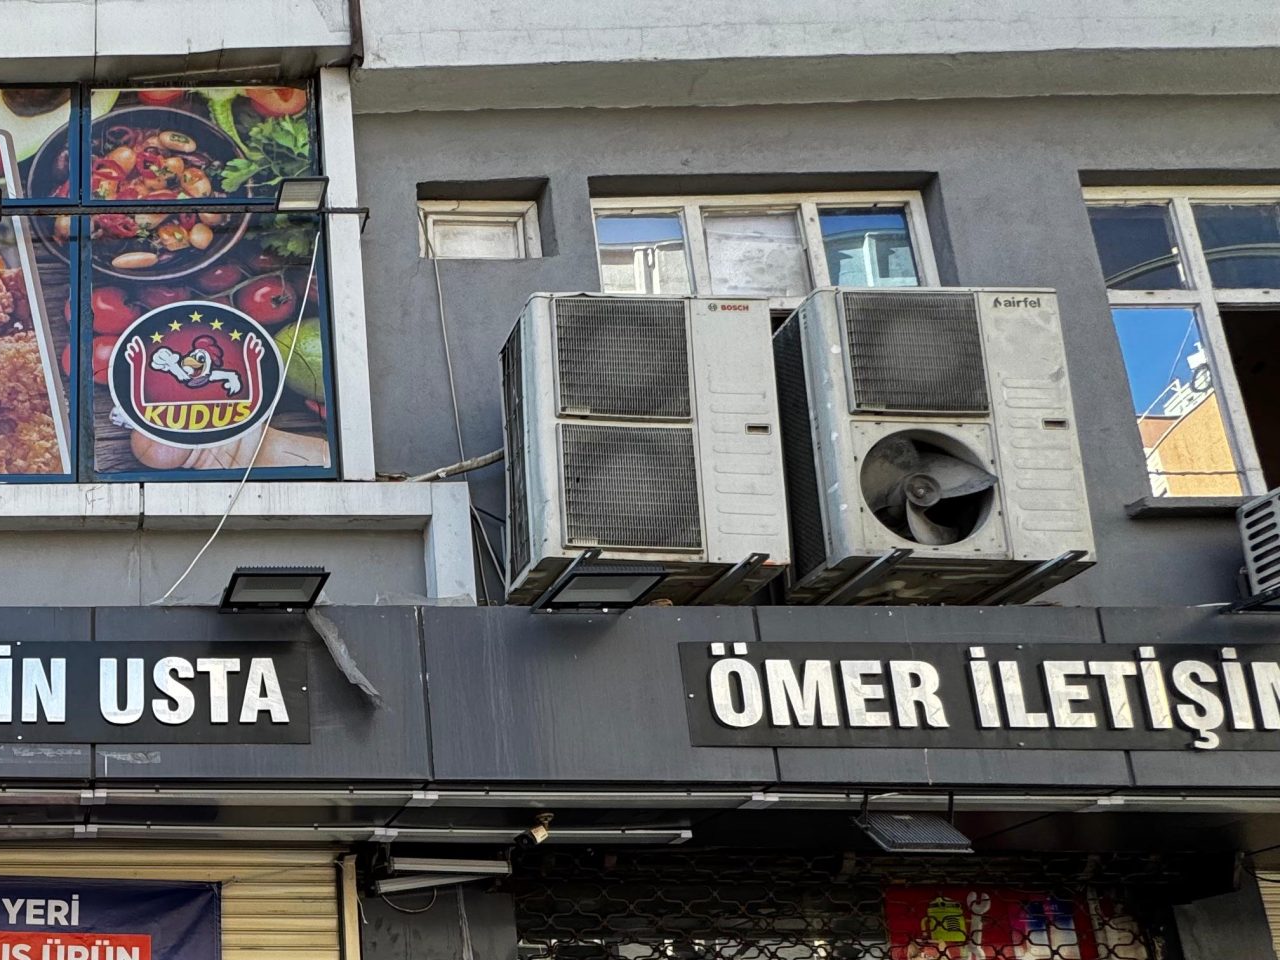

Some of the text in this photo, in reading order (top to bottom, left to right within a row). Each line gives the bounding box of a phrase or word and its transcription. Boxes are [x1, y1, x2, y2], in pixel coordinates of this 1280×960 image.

[721, 304, 749, 312] BOSCH
[1003, 297, 1041, 309] airfel
[144, 401, 252, 430] KUDÜS
[99, 657, 289, 725] USTA
[709, 642, 950, 729] ÖMER
[2, 894, 80, 926] YERİ
